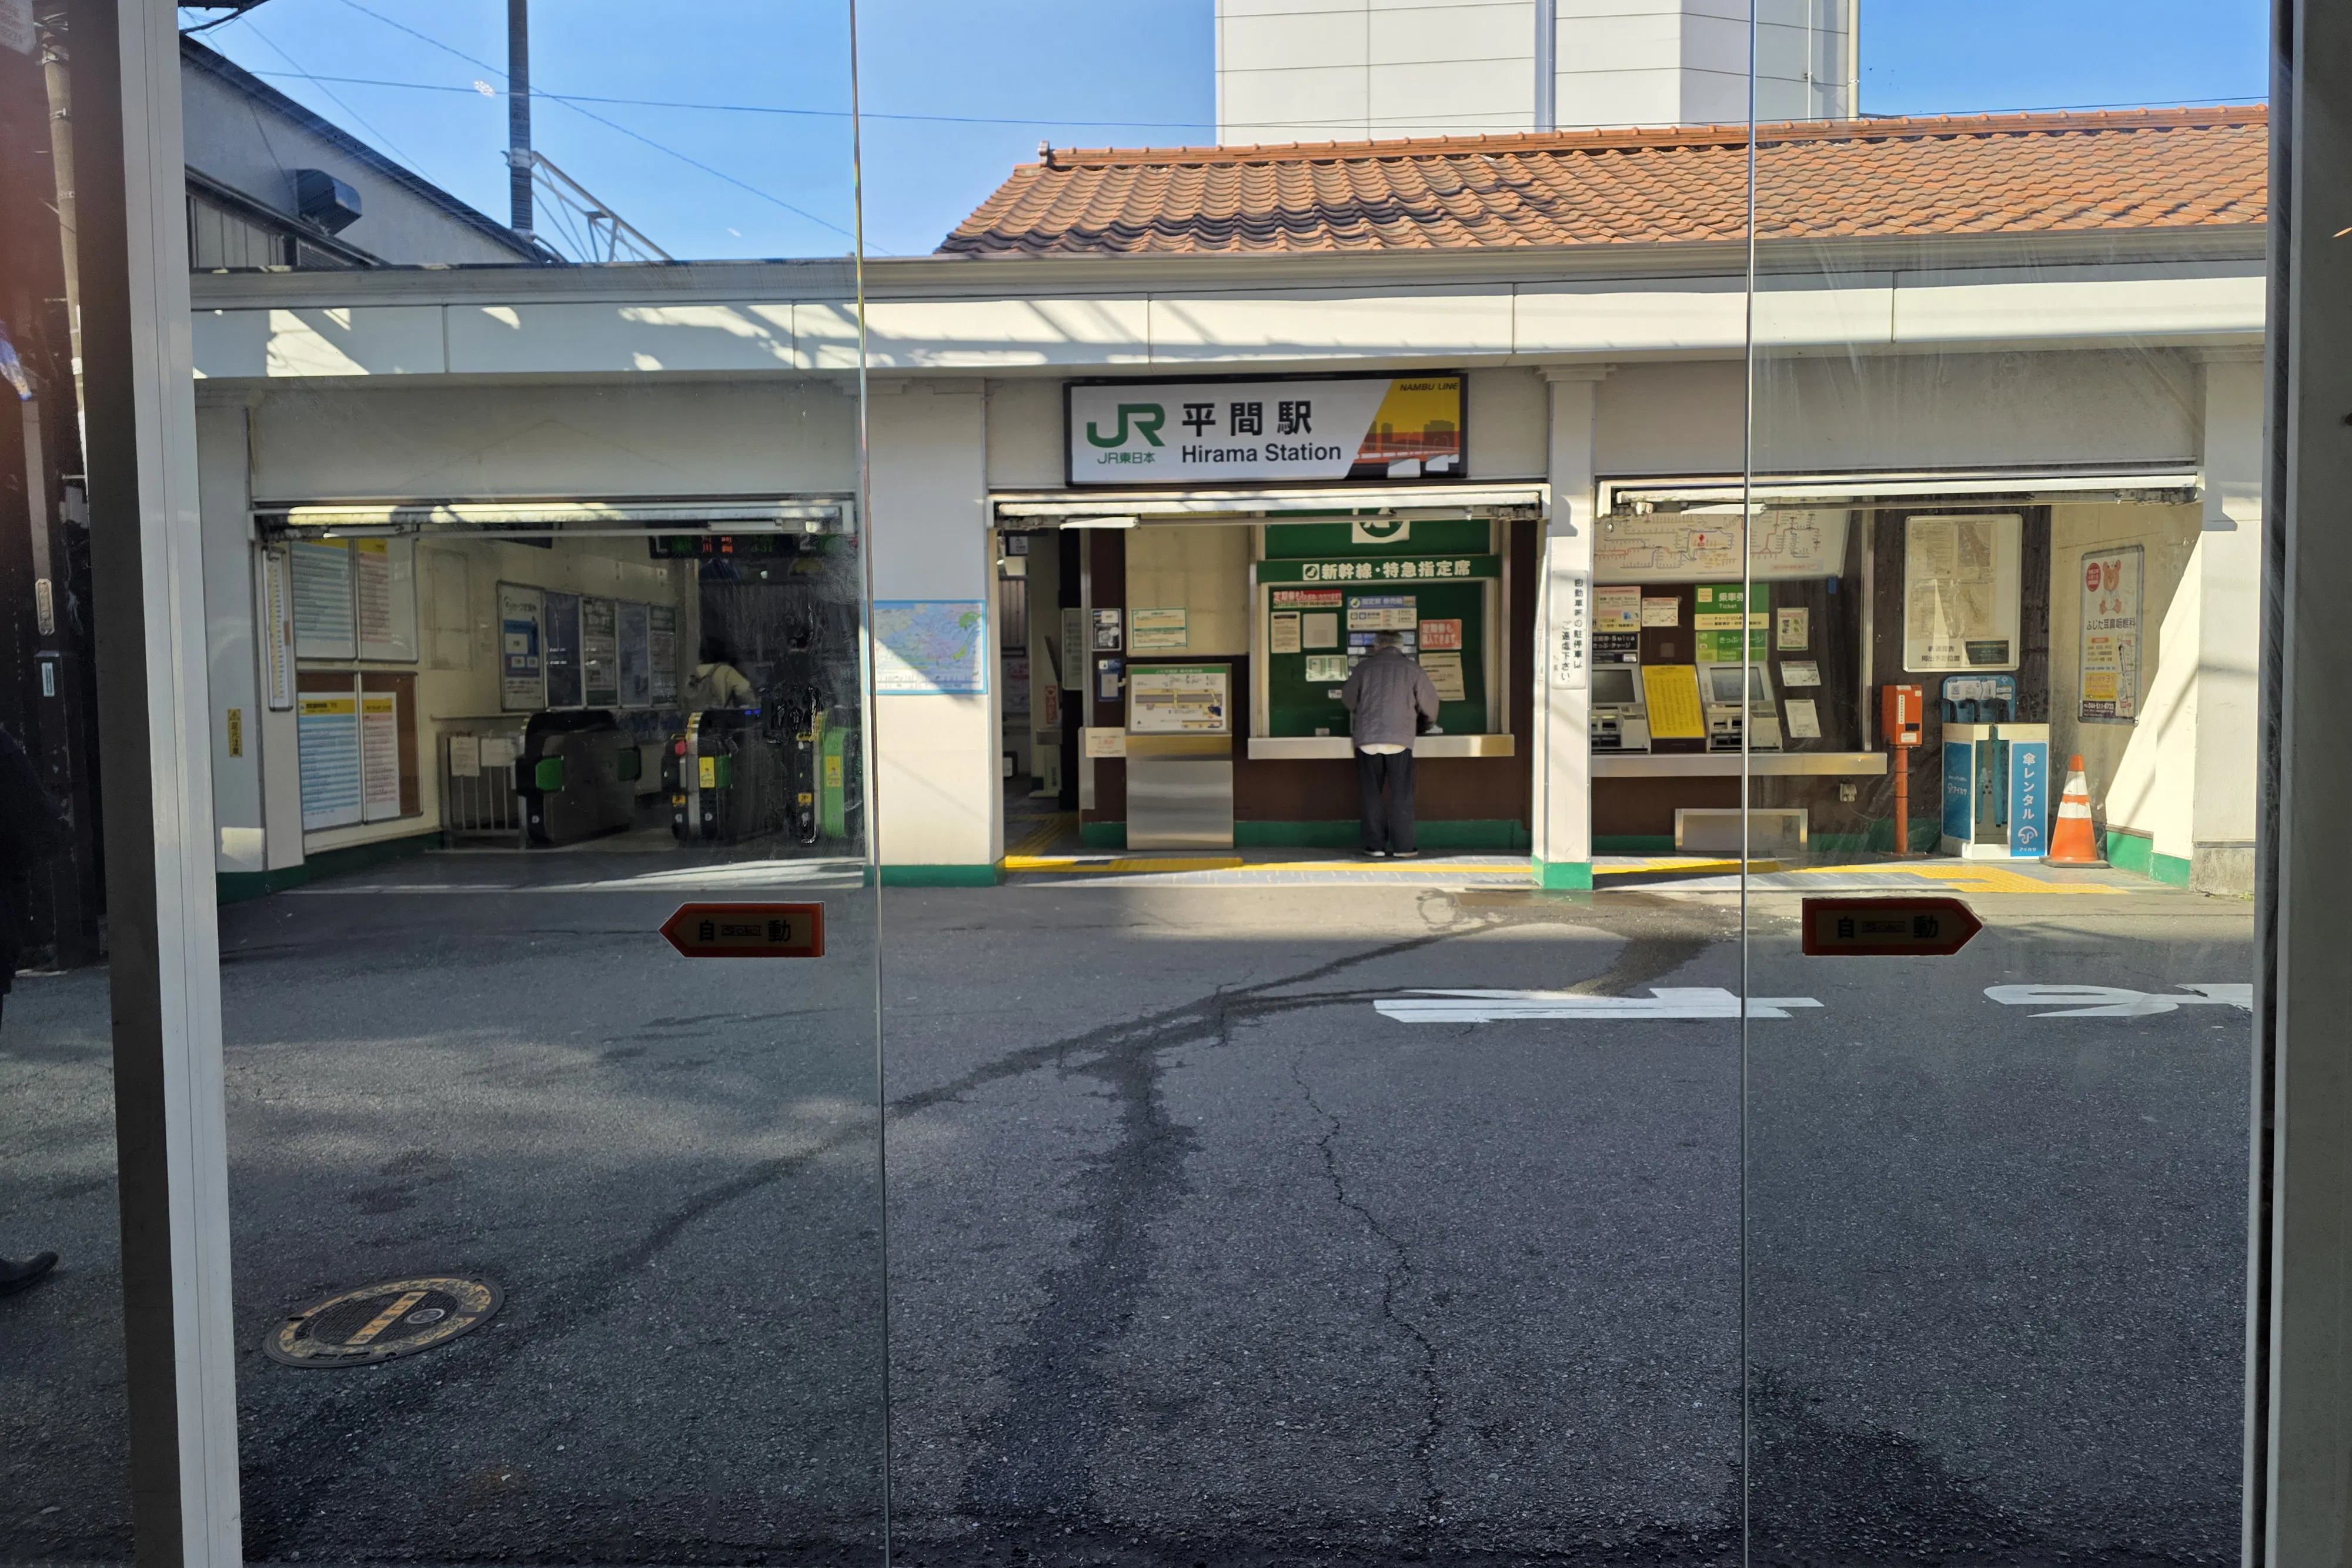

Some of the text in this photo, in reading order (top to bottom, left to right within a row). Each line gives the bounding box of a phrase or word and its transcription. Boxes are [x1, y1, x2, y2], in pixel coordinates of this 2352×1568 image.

[1087, 403, 1165, 448] JR
[1182, 400, 1312, 437] 平間駅
[1098, 452, 1155, 464] JR東日本
[1182, 443, 1341, 463] Hirama Station
[1321, 560, 1471, 580] 新幹線・特急指定席
[2086, 617, 2136, 631] ふじた耳鼻咽喉科
[2022, 752, 2036, 820] 傘レンタル
